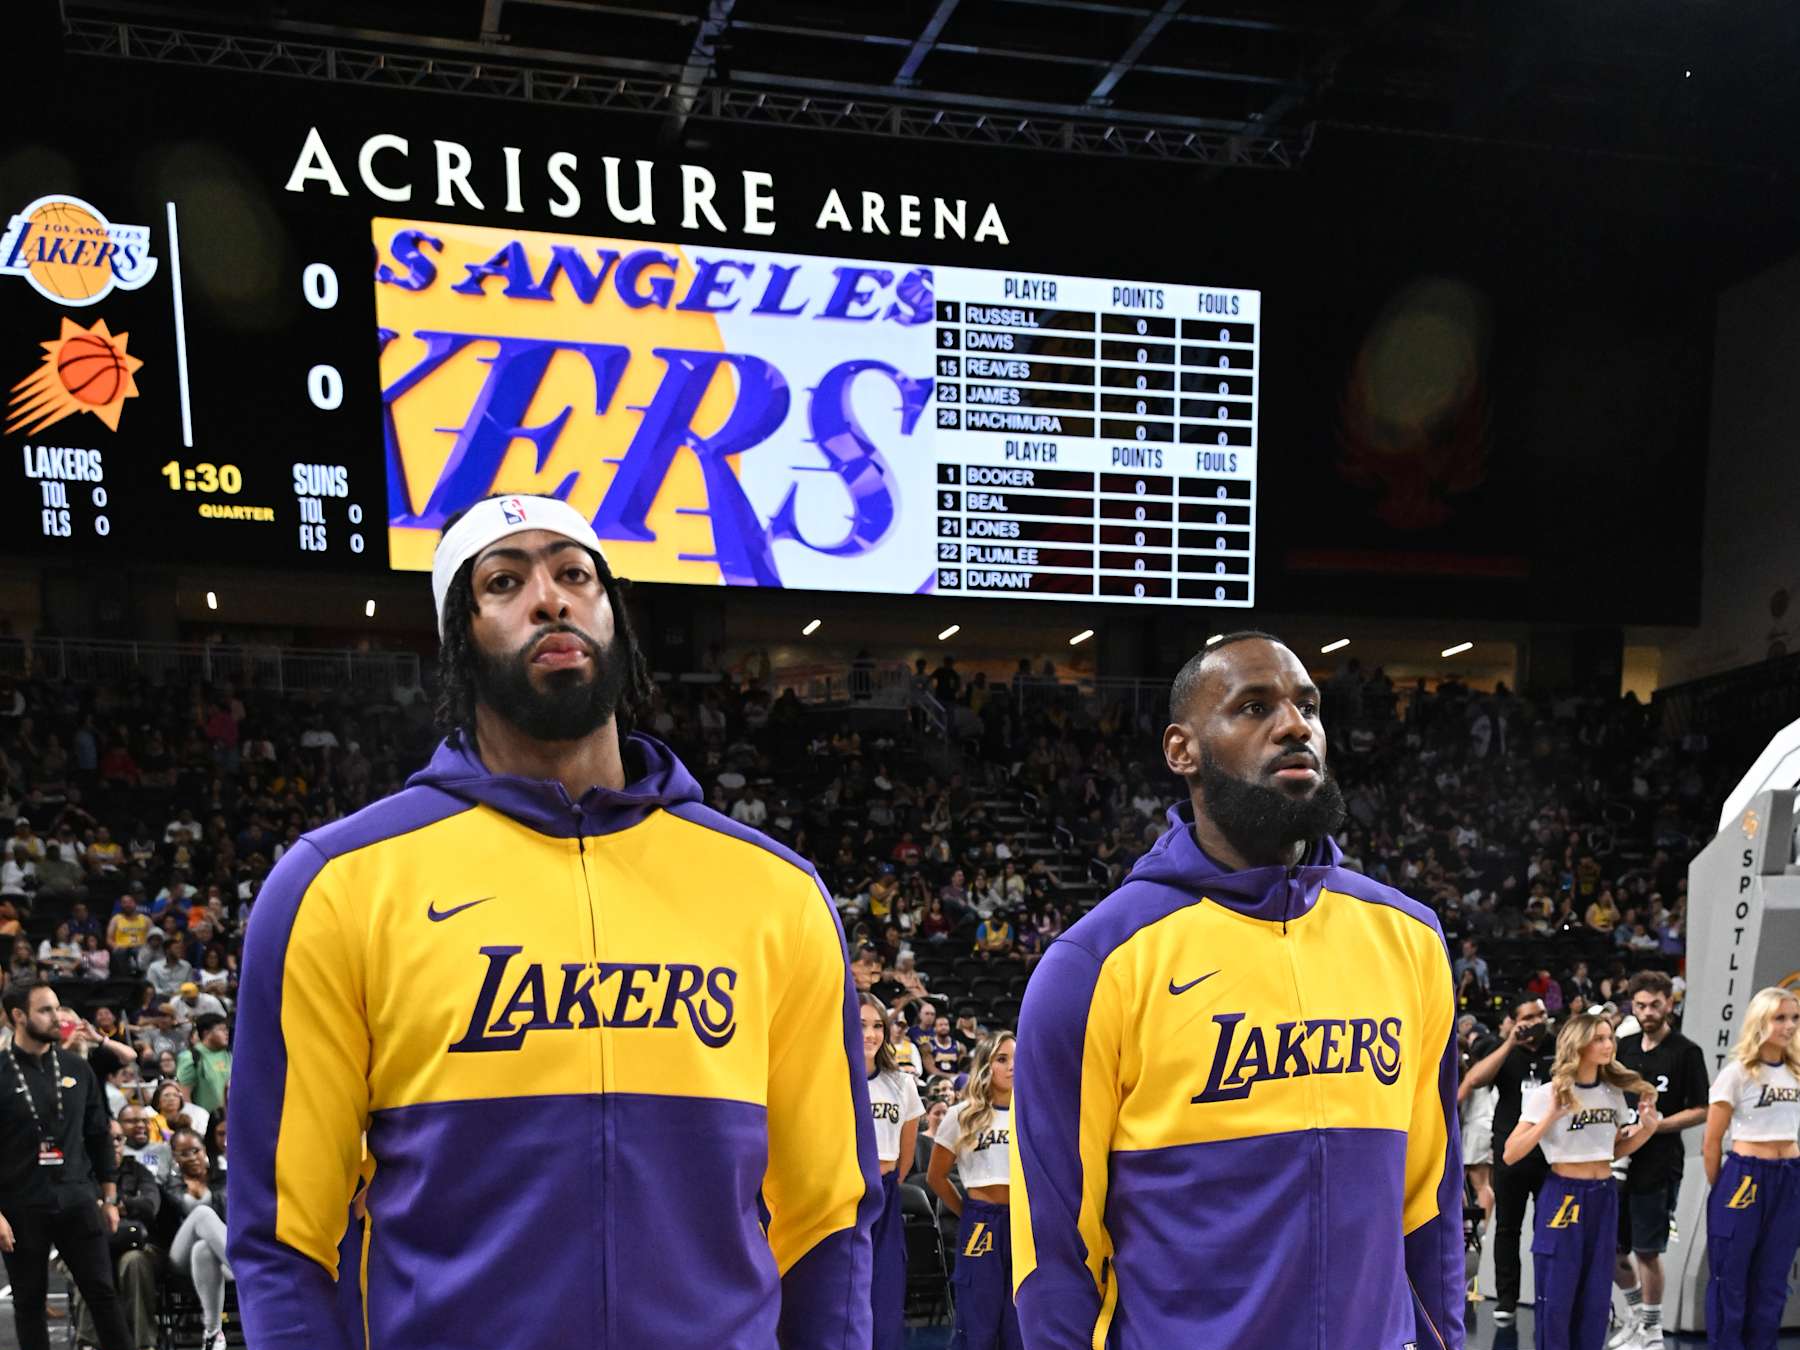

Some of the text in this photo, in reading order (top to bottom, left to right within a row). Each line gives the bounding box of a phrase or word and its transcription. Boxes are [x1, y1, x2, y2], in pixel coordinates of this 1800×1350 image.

[284, 126, 1010, 245] ACRISURE ARENA
[5, 221, 148, 283] LAKERS
[302, 262, 339, 310] 0
[450, 240, 934, 327] ANGELES
[1004, 278, 1240, 315] PLAYER POINTS FOULS
[944, 305, 953, 321] 1
[966, 306, 1039, 328] RUSSELL
[1136, 318, 1147, 335] 0
[943, 331, 953, 347] 3
[966, 331, 1015, 350] DAVIS
[1136, 348, 1147, 364] 0
[307, 364, 344, 411] 0
[940, 359, 957, 375] 15
[966, 358, 1031, 379] REAVES
[1136, 375, 1147, 390] 0
[939, 384, 957, 401] 23
[966, 386, 1020, 407] JAMES
[1136, 400, 1147, 416] 0
[966, 411, 1063, 433] HACHIMURA
[1136, 424, 1147, 441] 0
[23, 445, 104, 482] LAKERS
[1005, 440, 1237, 473] PLAYER POINTS FOULS
[161, 460, 242, 494] 1:30
[293, 463, 349, 498] SUNS
[946, 467, 954, 483] 1
[967, 467, 1035, 487] BOOKER
[1135, 480, 1146, 496] 0
[40, 480, 107, 509] TOL 0
[298, 497, 362, 524] TOL 0
[943, 492, 953, 509] 3
[967, 493, 1008, 512] BEAL
[1135, 506, 1146, 521] 0
[42, 508, 110, 537] FLS 0
[198, 503, 275, 522] QUARTER
[299, 524, 364, 553] FLS 0
[941, 518, 959, 535] 21
[967, 520, 1020, 538] JONES
[1135, 531, 1146, 547] 0
[940, 543, 958, 560] 22
[967, 546, 1039, 565] PLUMLEE
[1134, 558, 1145, 571] 0
[940, 570, 958, 587] 35
[967, 571, 1033, 589] DURANT
[1134, 583, 1145, 599] 0
[1715, 848, 1754, 1071] SPOTLIGHT
[447, 945, 738, 1053] LAKERS
[1190, 1012, 1402, 1105] LAKERS
[1546, 1194, 1580, 1229] LA
[962, 1222, 994, 1257] LA
